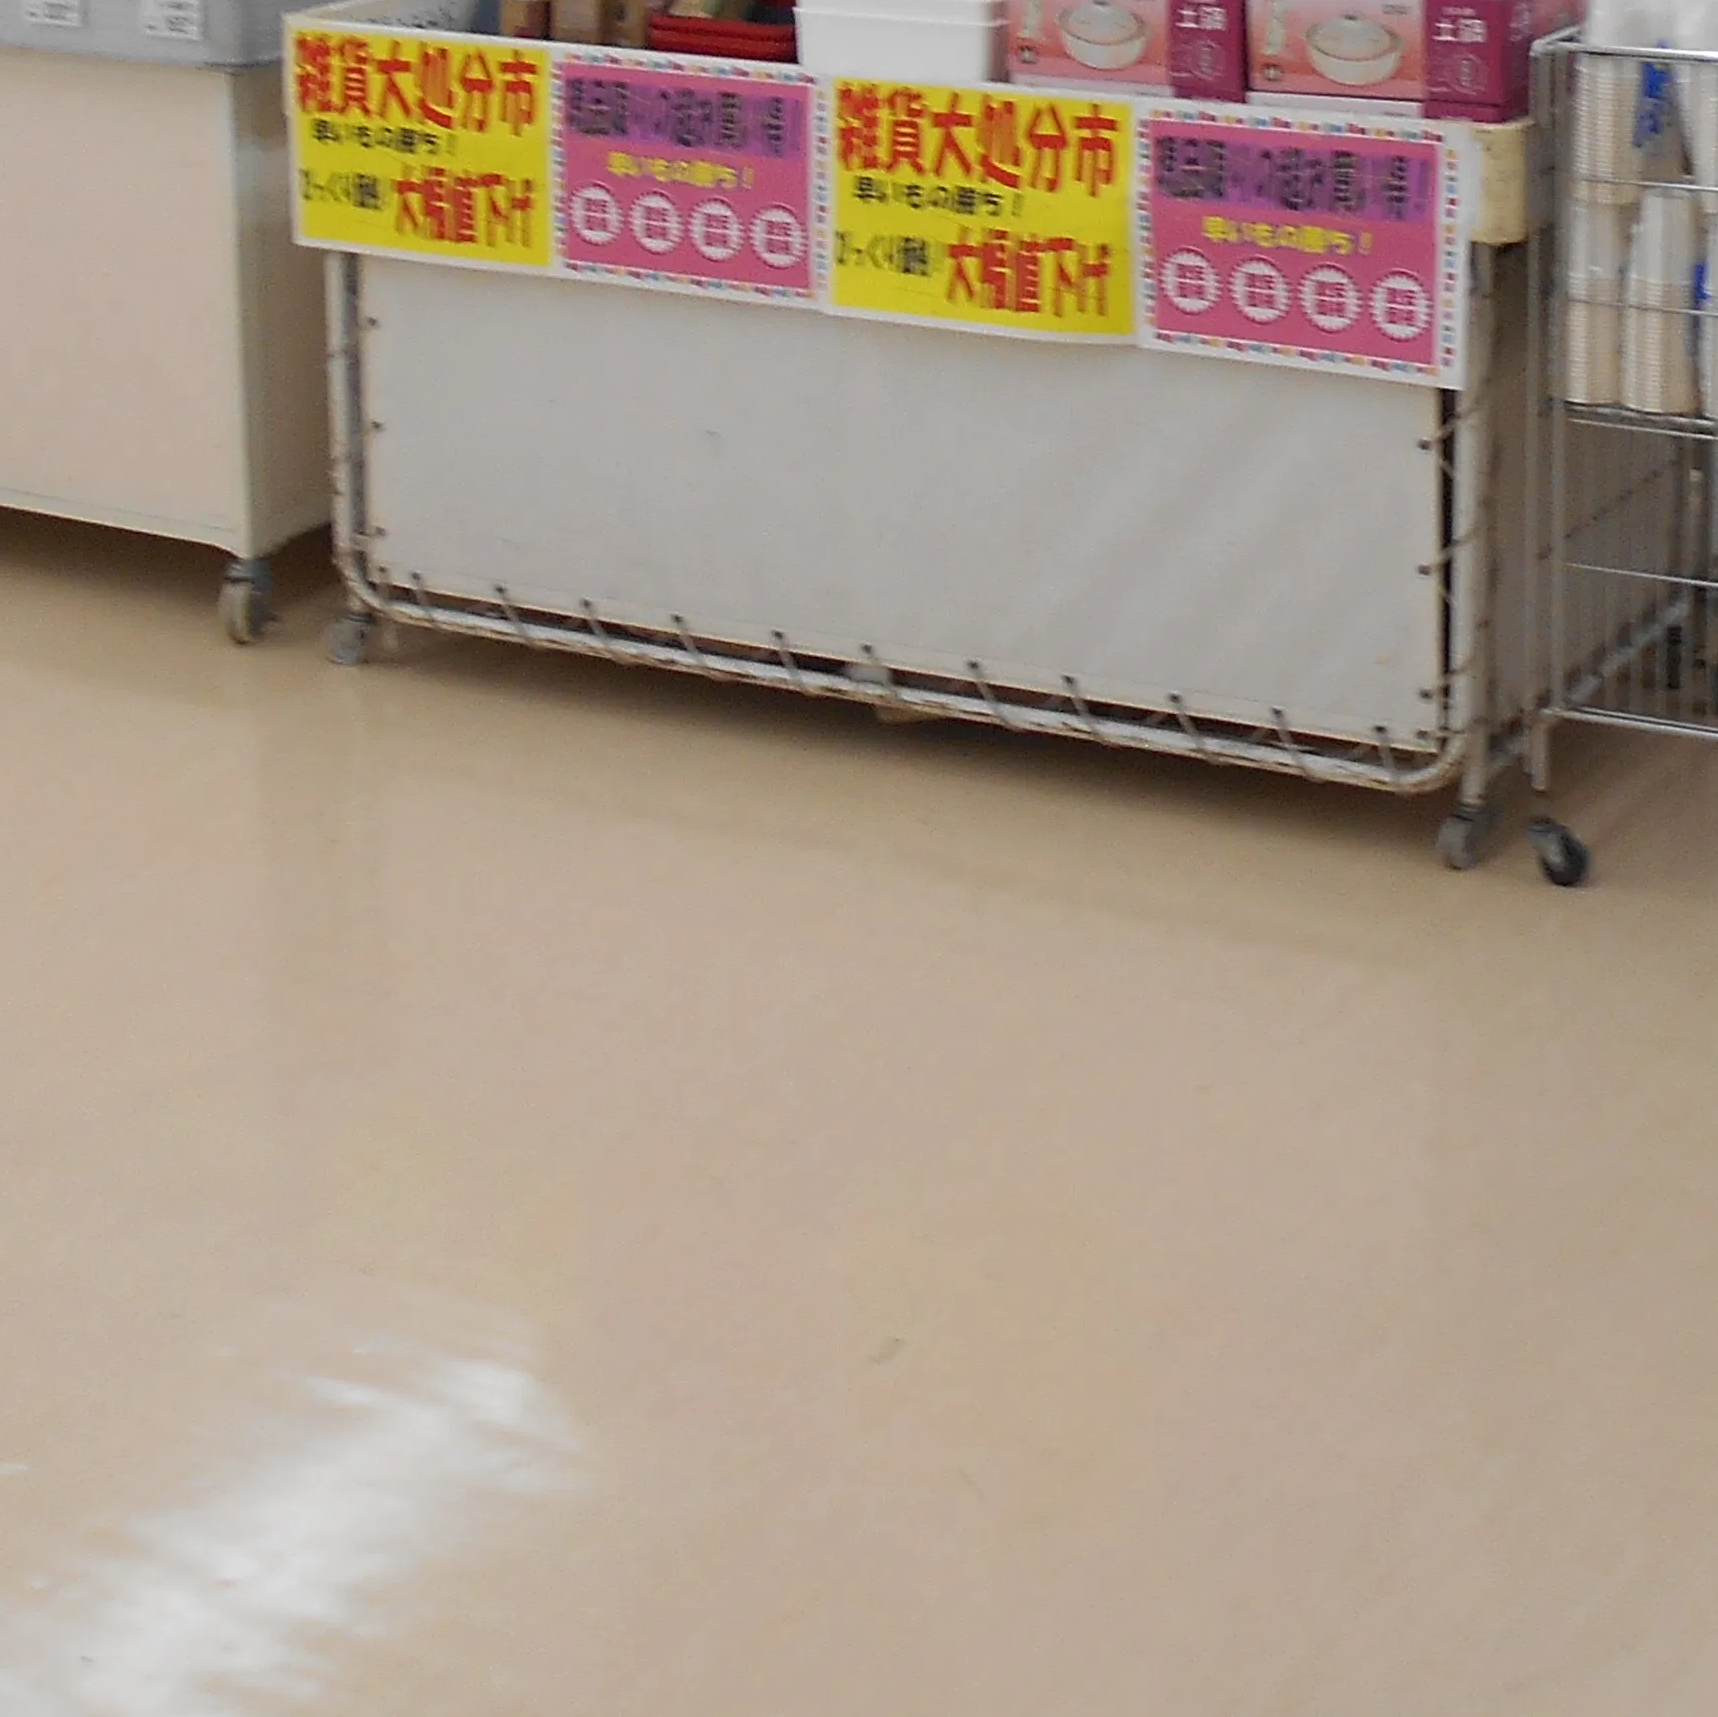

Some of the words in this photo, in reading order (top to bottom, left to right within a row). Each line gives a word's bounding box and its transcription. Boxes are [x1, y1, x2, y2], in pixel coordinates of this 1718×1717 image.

[1431, 18, 1487, 43] 土鍋
[295, 33, 539, 138] 雑貨大処分市
[836, 81, 1120, 198] 雑貨大処分市
[394, 164, 534, 249] 大幅値下げ
[946, 226, 1112, 319] 大幅値下げ
